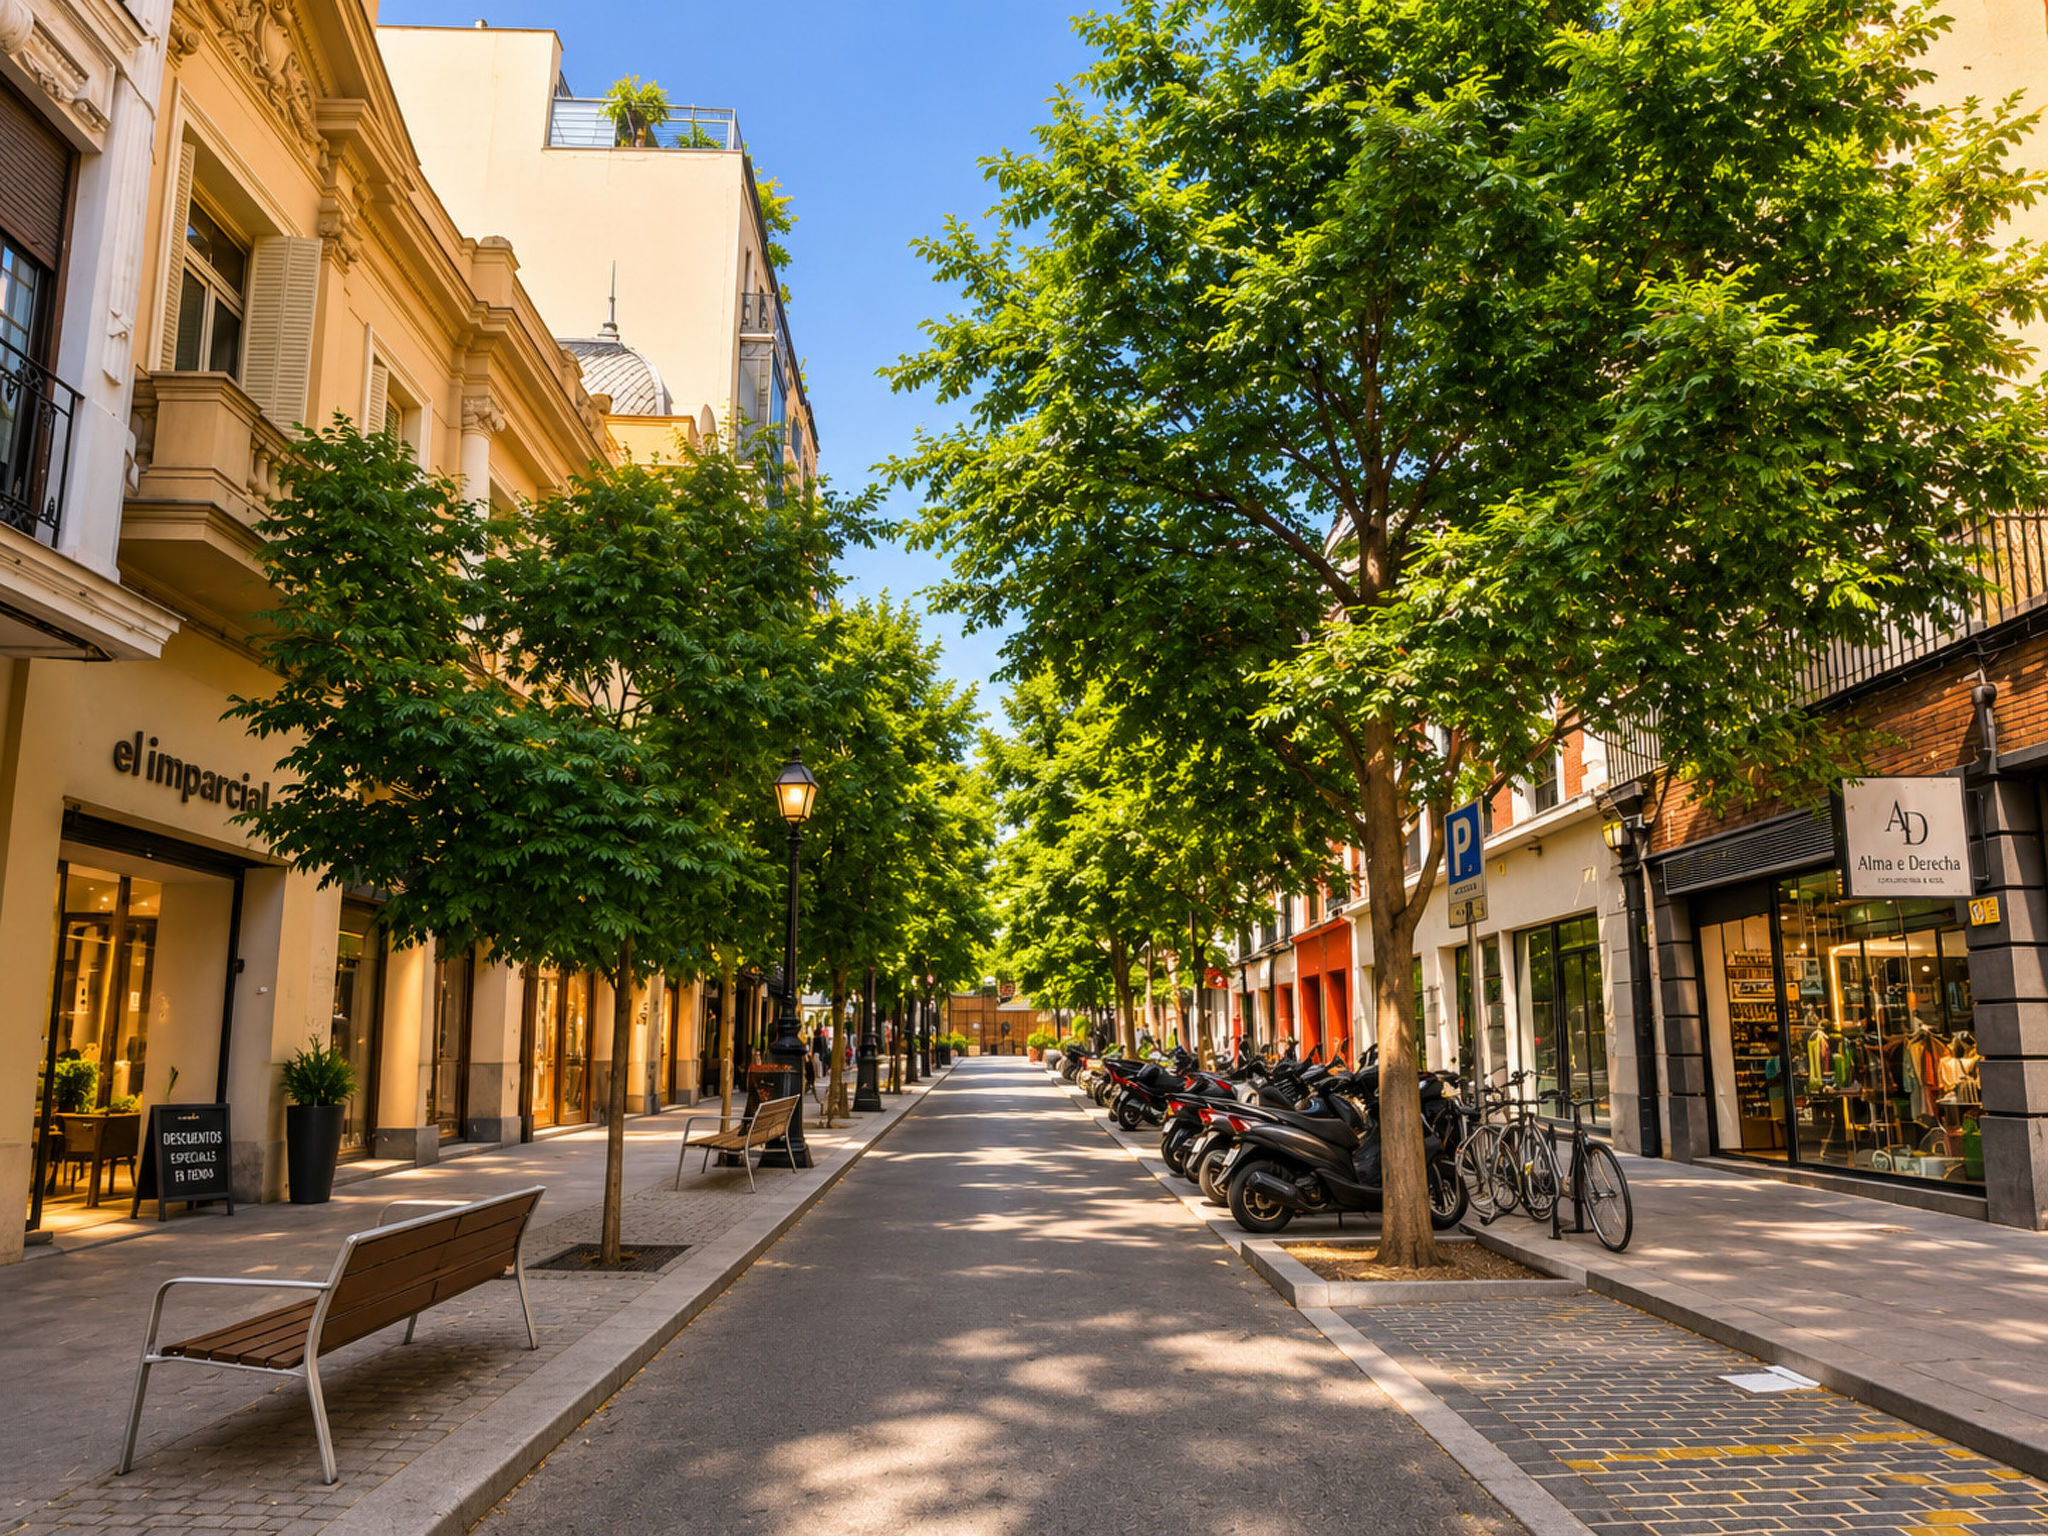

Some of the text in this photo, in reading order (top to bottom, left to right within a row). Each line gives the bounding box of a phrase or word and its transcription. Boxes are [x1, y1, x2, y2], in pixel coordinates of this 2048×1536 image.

[113, 731, 270, 812] el imparcial
[1453, 817, 1471, 877] P
[1858, 855, 1961, 871] Alma e Derecha
[163, 1131, 223, 1146] DESCUENTOS
